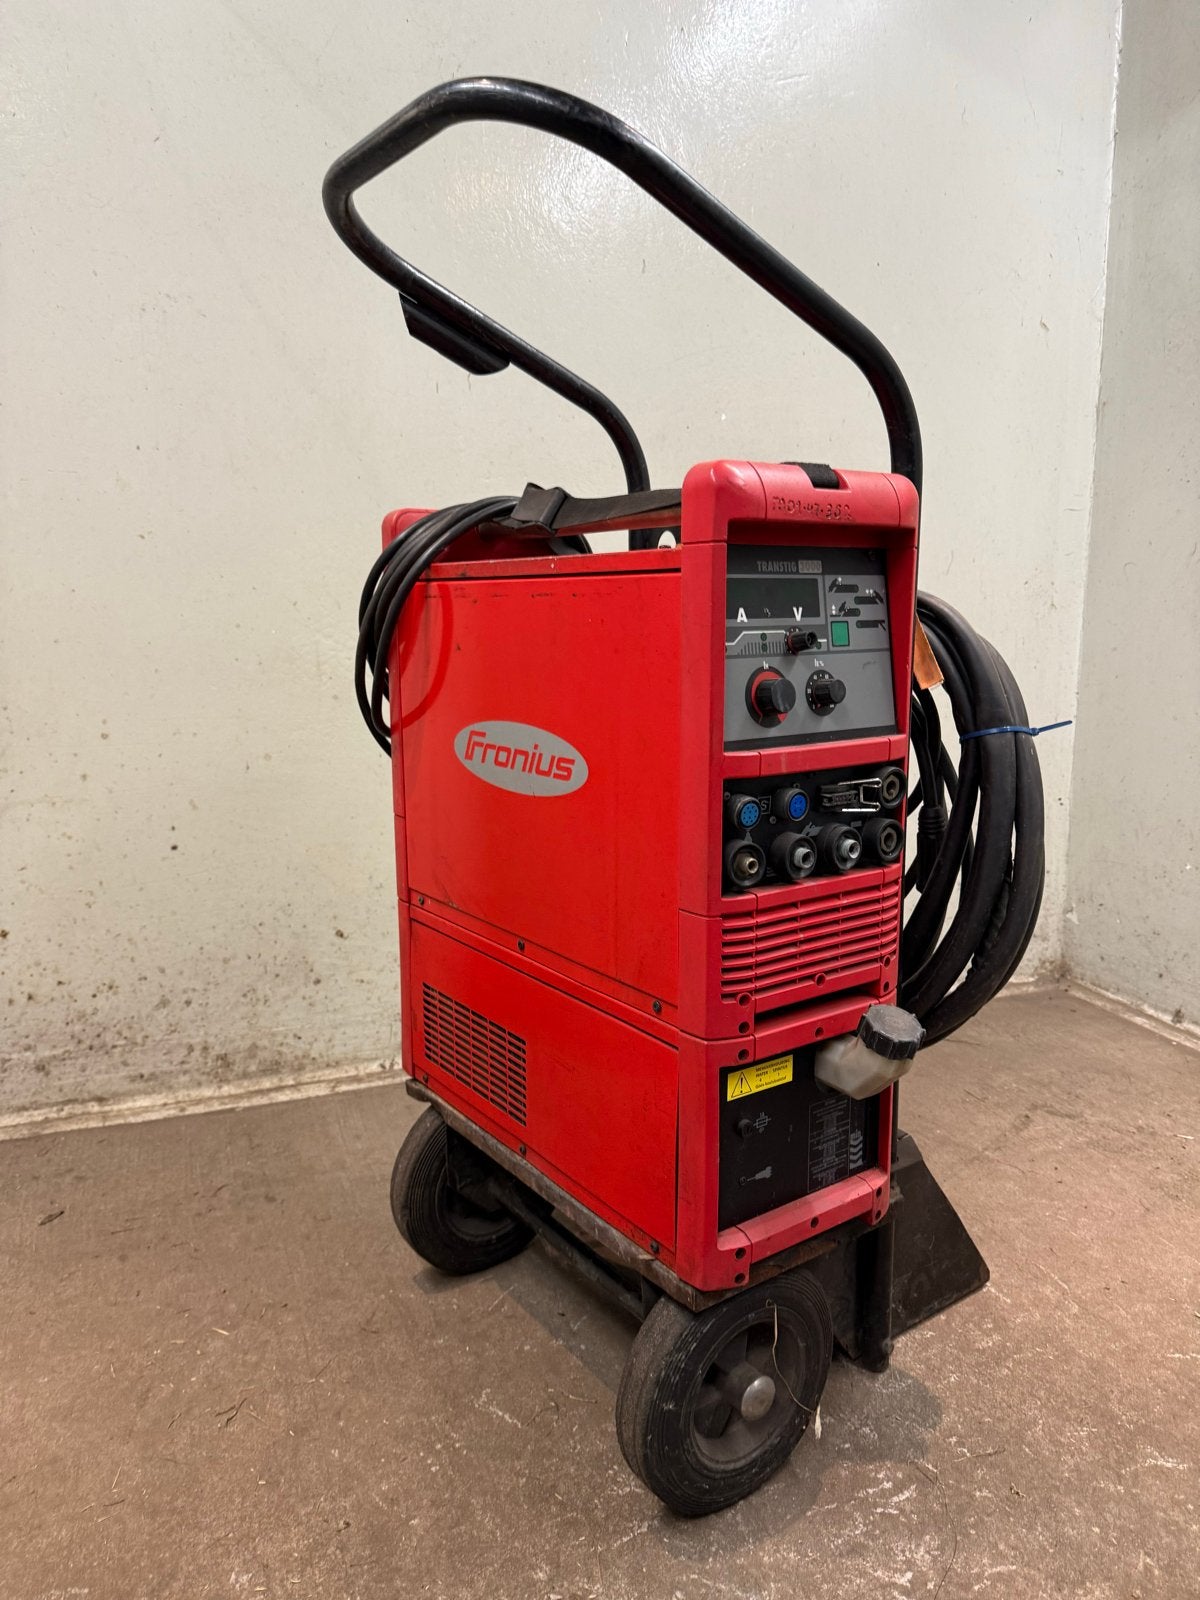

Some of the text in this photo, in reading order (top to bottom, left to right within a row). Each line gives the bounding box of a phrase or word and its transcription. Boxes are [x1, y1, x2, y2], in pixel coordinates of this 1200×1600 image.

[757, 560, 797, 573] TRANSTIG
[736, 607, 748, 623] A
[792, 606, 803, 622] V
[464, 729, 576, 782] Fronius
